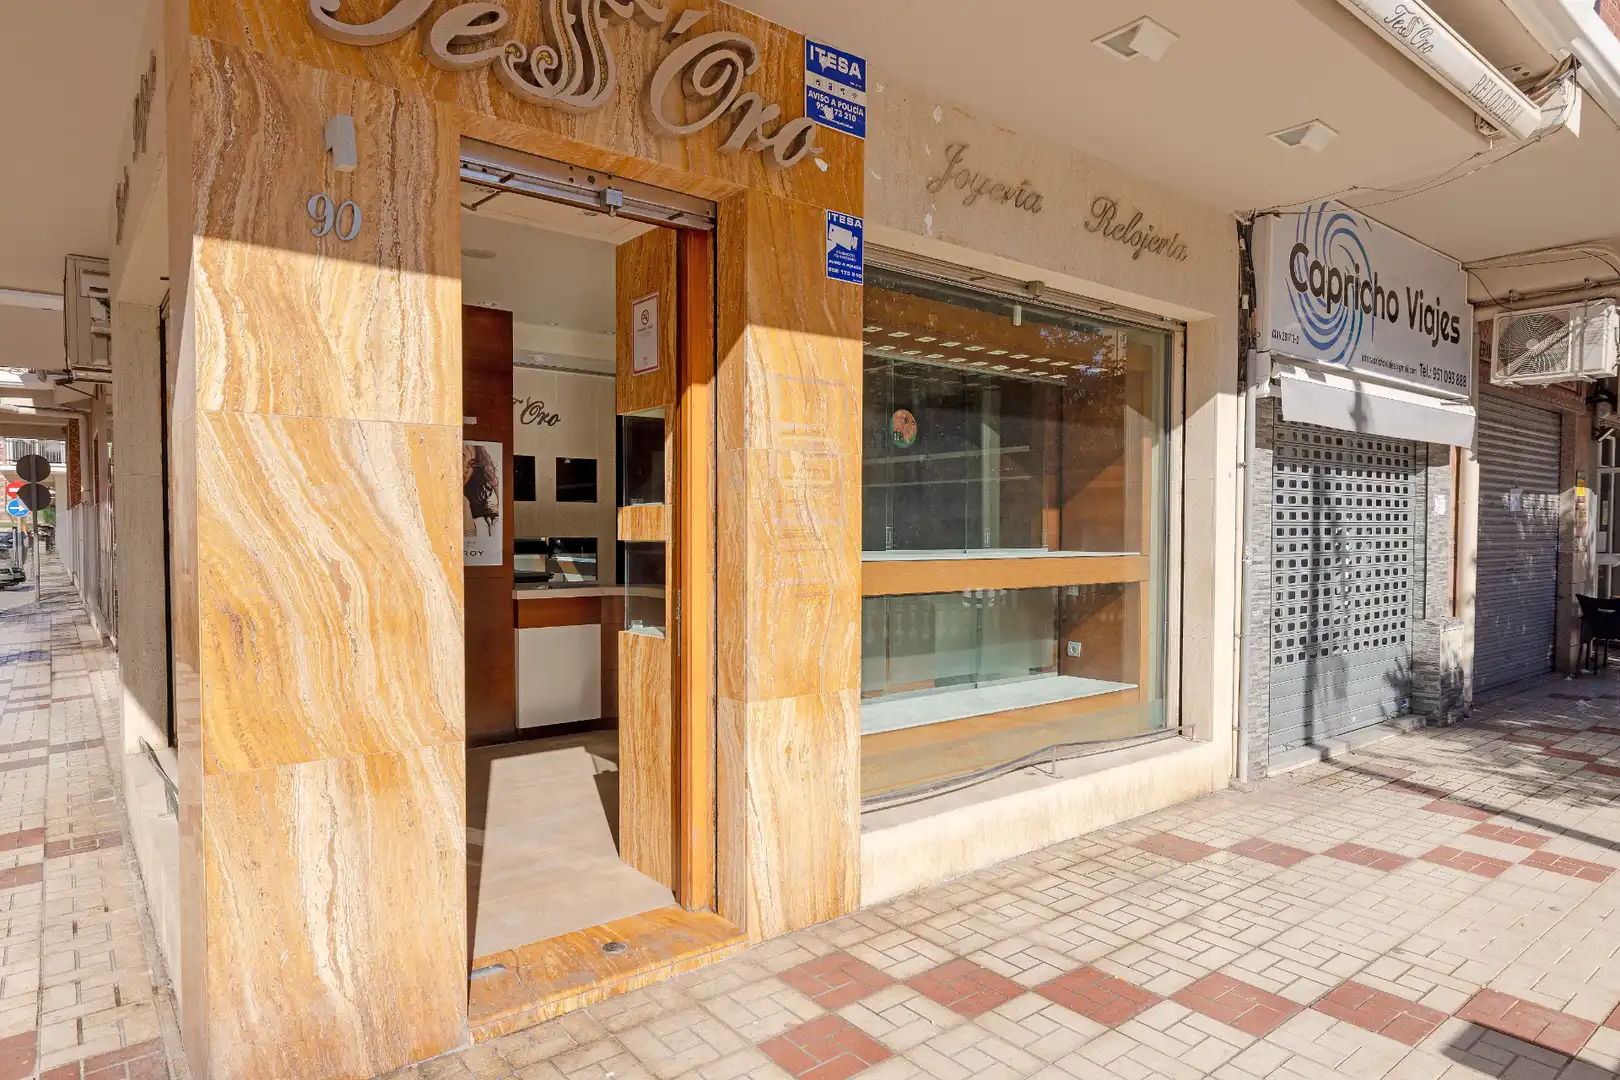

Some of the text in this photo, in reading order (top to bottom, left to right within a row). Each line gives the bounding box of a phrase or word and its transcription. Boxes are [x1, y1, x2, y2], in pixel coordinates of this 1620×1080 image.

[810, 44, 862, 80] ITESA
[808, 90, 864, 116] AVISO A POLICÍA
[844, 112, 857, 122] 210
[307, 192, 363, 241] 90
[828, 212, 862, 228] ITESA
[1289, 242, 1460, 348] Capricho Viajes
[1433, 367, 1443, 382] 951
[1444, 370, 1455, 384] 093
[1456, 373, 1467, 388] 888
